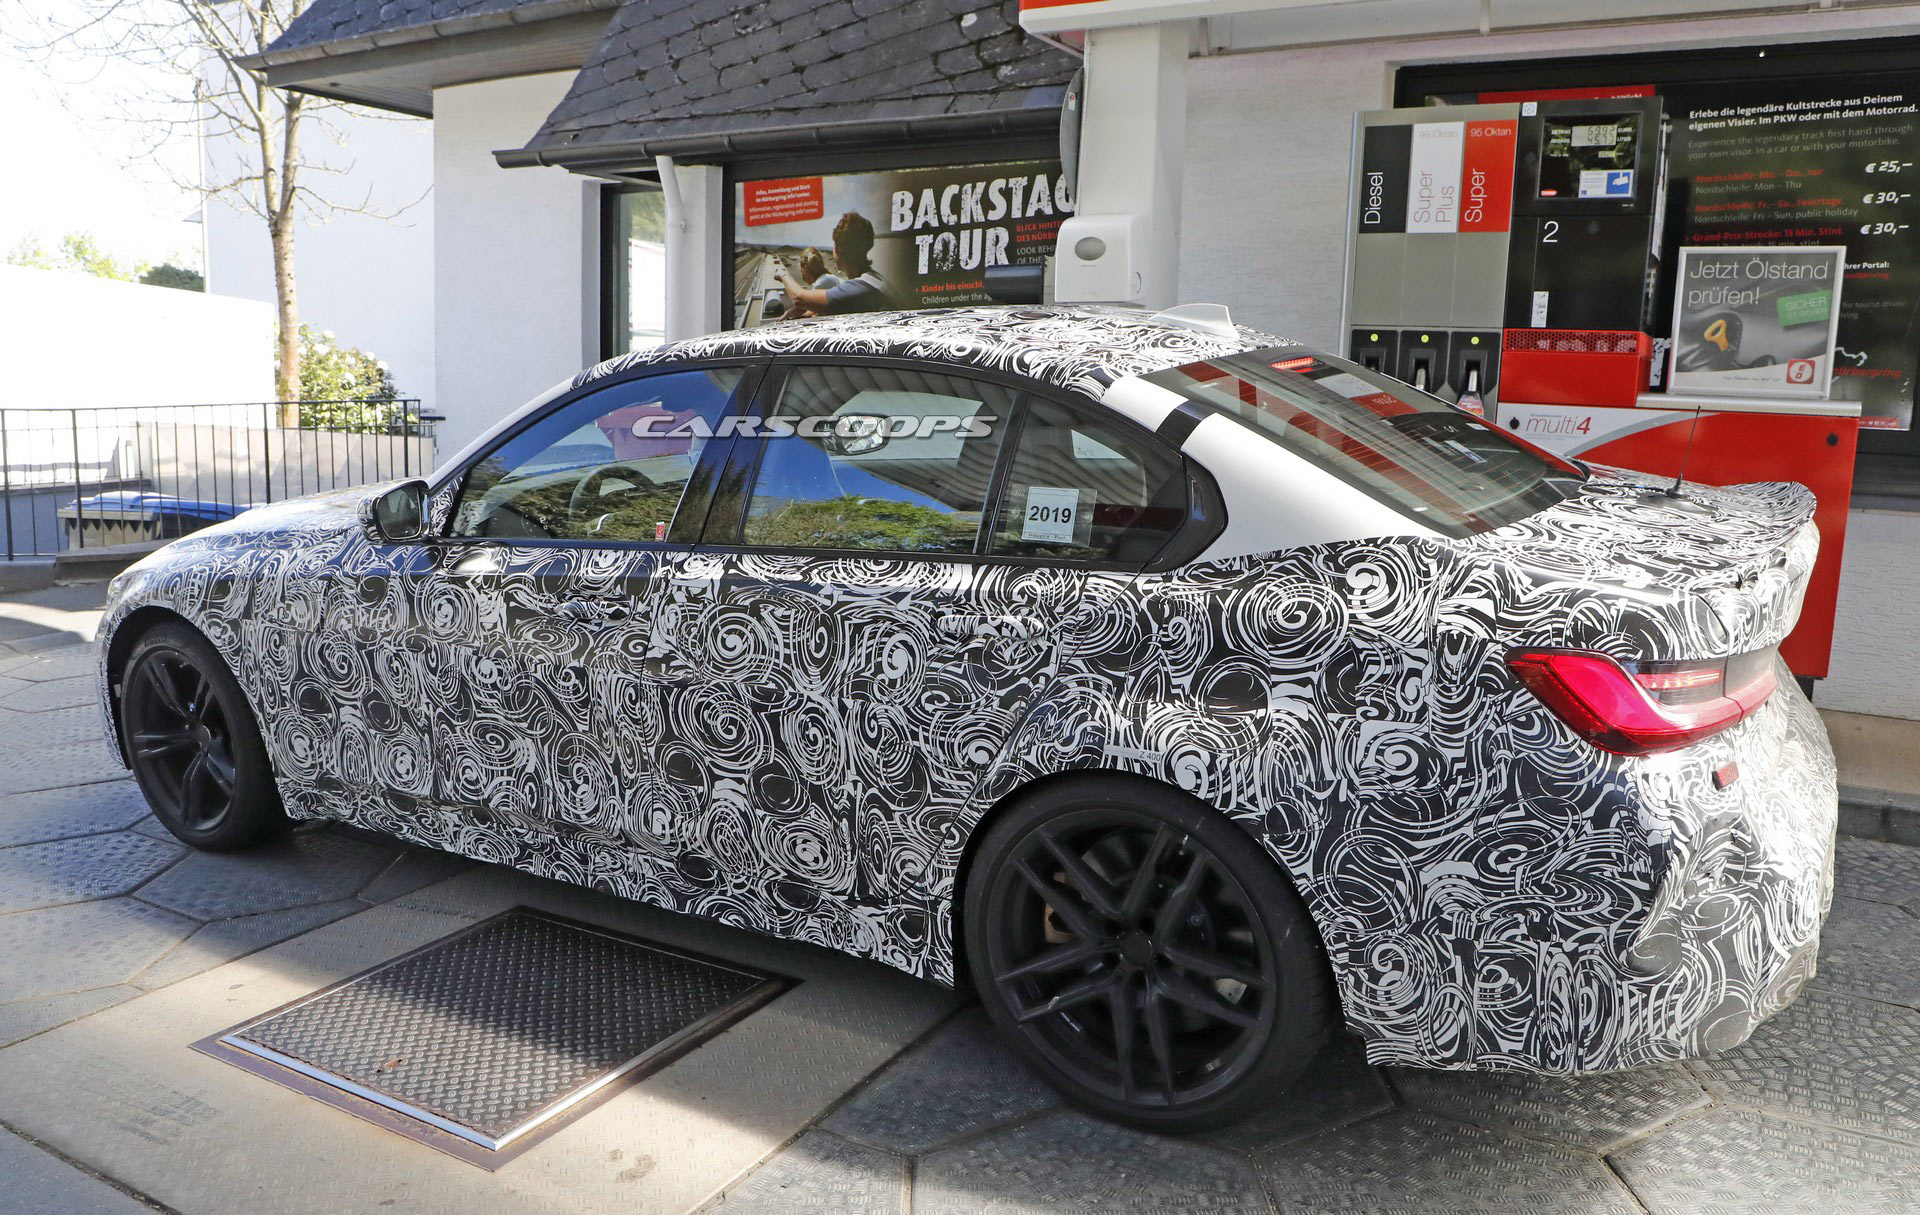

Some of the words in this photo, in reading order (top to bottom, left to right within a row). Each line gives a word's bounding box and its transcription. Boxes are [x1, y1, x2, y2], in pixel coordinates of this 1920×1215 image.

[1689, 110, 1719, 119] Erlebe
[1720, 107, 1735, 116] die
[1737, 104, 1785, 116] legendäre
[1786, 98, 1842, 111] Kultstrecke
[1844, 98, 1861, 106] aus
[1863, 94, 1903, 104] Deinem
[1688, 120, 1726, 131] eigenen
[1727, 118, 1757, 127] Visier.
[1759, 116, 1771, 124] Im
[1773, 113, 1797, 123] PKW
[1798, 112, 1821, 121] oder
[1823, 110, 1840, 119] mit
[1842, 108, 1864, 117] dem
[1866, 103, 1918, 116] Motorrad.
[1433, 128, 1458, 138] Oktan
[1470, 128, 1482, 137] 95
[1484, 126, 1511, 137] Oktan
[1688, 138, 1736, 149] Experience
[1738, 136, 1753, 144] the
[1755, 132, 1800, 145] legendary
[1802, 130, 1825, 139] track
[1828, 128, 1845, 138] first
[1848, 126, 1872, 136] hand
[1875, 124, 1913, 135] through
[1688, 150, 1707, 160] your
[1709, 150, 1728, 158] own
[1774, 145, 1788, 153] car
[1803, 141, 1823, 151] with
[1826, 141, 1846, 151] your
[1865, 163, 1876, 173] €
[1754, 183, 1775, 191] Mon
[1785, 181, 1802, 189] Thu
[1364, 172, 1383, 224] Diesel
[1414, 170, 1434, 223] Super
[1464, 168, 1487, 222] Super
[1863, 194, 1874, 204] €
[1435, 185, 1455, 223] Plus
[1795, 207, 1822, 219] public
[1825, 207, 1859, 217] holiday
[1016, 223, 1038, 232] BLICK
[1542, 220, 1559, 243] 2
[1860, 224, 1871, 234] €
[1016, 234, 1031, 242] DES
[915, 226, 1009, 275] TOUR
[1016, 246, 1037, 255] LOOK
[1016, 257, 1027, 265] OF
[1029, 256, 1043, 264] THE
[1690, 261, 1739, 279] Jetzt
[1746, 257, 1829, 279] Ölstand
[1862, 261, 1890, 269] Portal:
[921, 284, 945, 293] Kinder
[946, 282, 957, 291] bis
[922, 295, 950, 304] Children
[951, 293, 970, 302] under
[971, 292, 983, 301] the
[1688, 286, 1760, 307] prüfen!
[1785, 296, 1827, 311] SICHER
[1526, 416, 1592, 435] multi4
[1028, 506, 1072, 524] 2019
